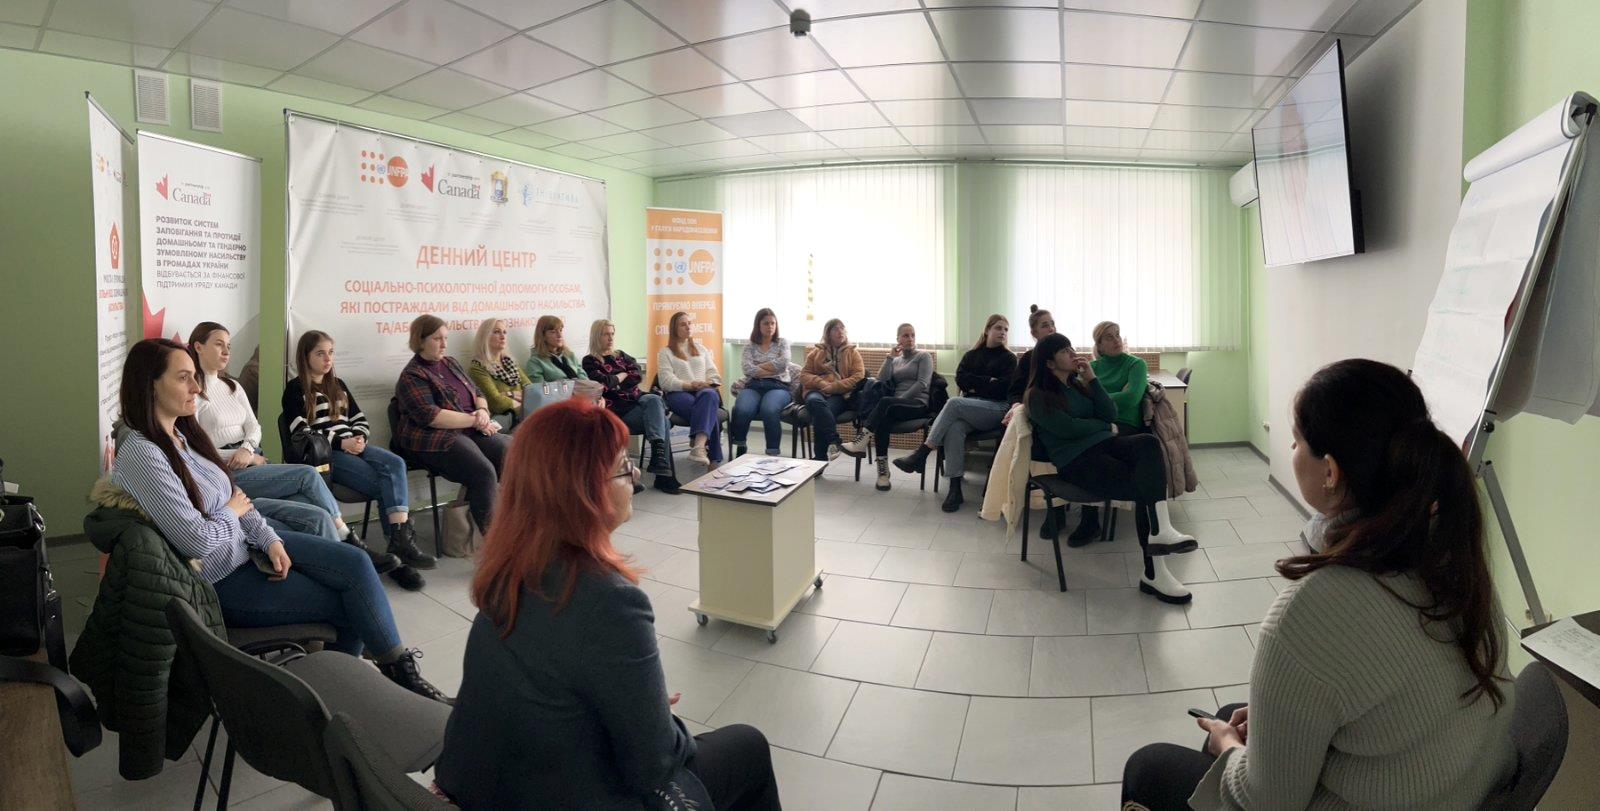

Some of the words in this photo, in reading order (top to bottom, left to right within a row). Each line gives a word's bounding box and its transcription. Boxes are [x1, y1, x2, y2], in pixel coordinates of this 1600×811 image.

[438, 179, 480, 199] Canada
[172, 187, 211, 206] Canada
[156, 216, 192, 226] РОЗВИТОК
[194, 220, 219, 228] СИСТЕМ
[156, 227, 202, 237] ЗАПОБІГАННЯ
[156, 238, 207, 248] ДОМАШНЬОМУ
[217, 243, 247, 251] ГЕНДЕРНО
[156, 249, 207, 258] ЗУМОВЛЕНОМУ
[208, 252, 246, 260] НАСИЛЬСТВУ
[416, 244, 487, 269] ДЕННИЙ
[492, 250, 537, 272] ЦЕНТР
[163, 260, 201, 268] ГРОМАДАХ
[202, 261, 229, 269] УКРАЇНИ
[689, 260, 715, 273] UNFPA
[344, 280, 497, 296] СОЦІАЛЬНО-ПСИХОЛОГІЧНОЇ
[500, 283, 548, 295] ДОПОМОГИ
[340, 301, 360, 314] ЯКІ
[363, 301, 449, 314] ПОСТРАЖДАЛИ
[452, 301, 469, 314] ВІД
[471, 300, 536, 314] ДОМАШНЬОГО
[538, 299, 586, 309] НАСИЛЬСТВА
[376, 322, 411, 335] ТА/АБ
